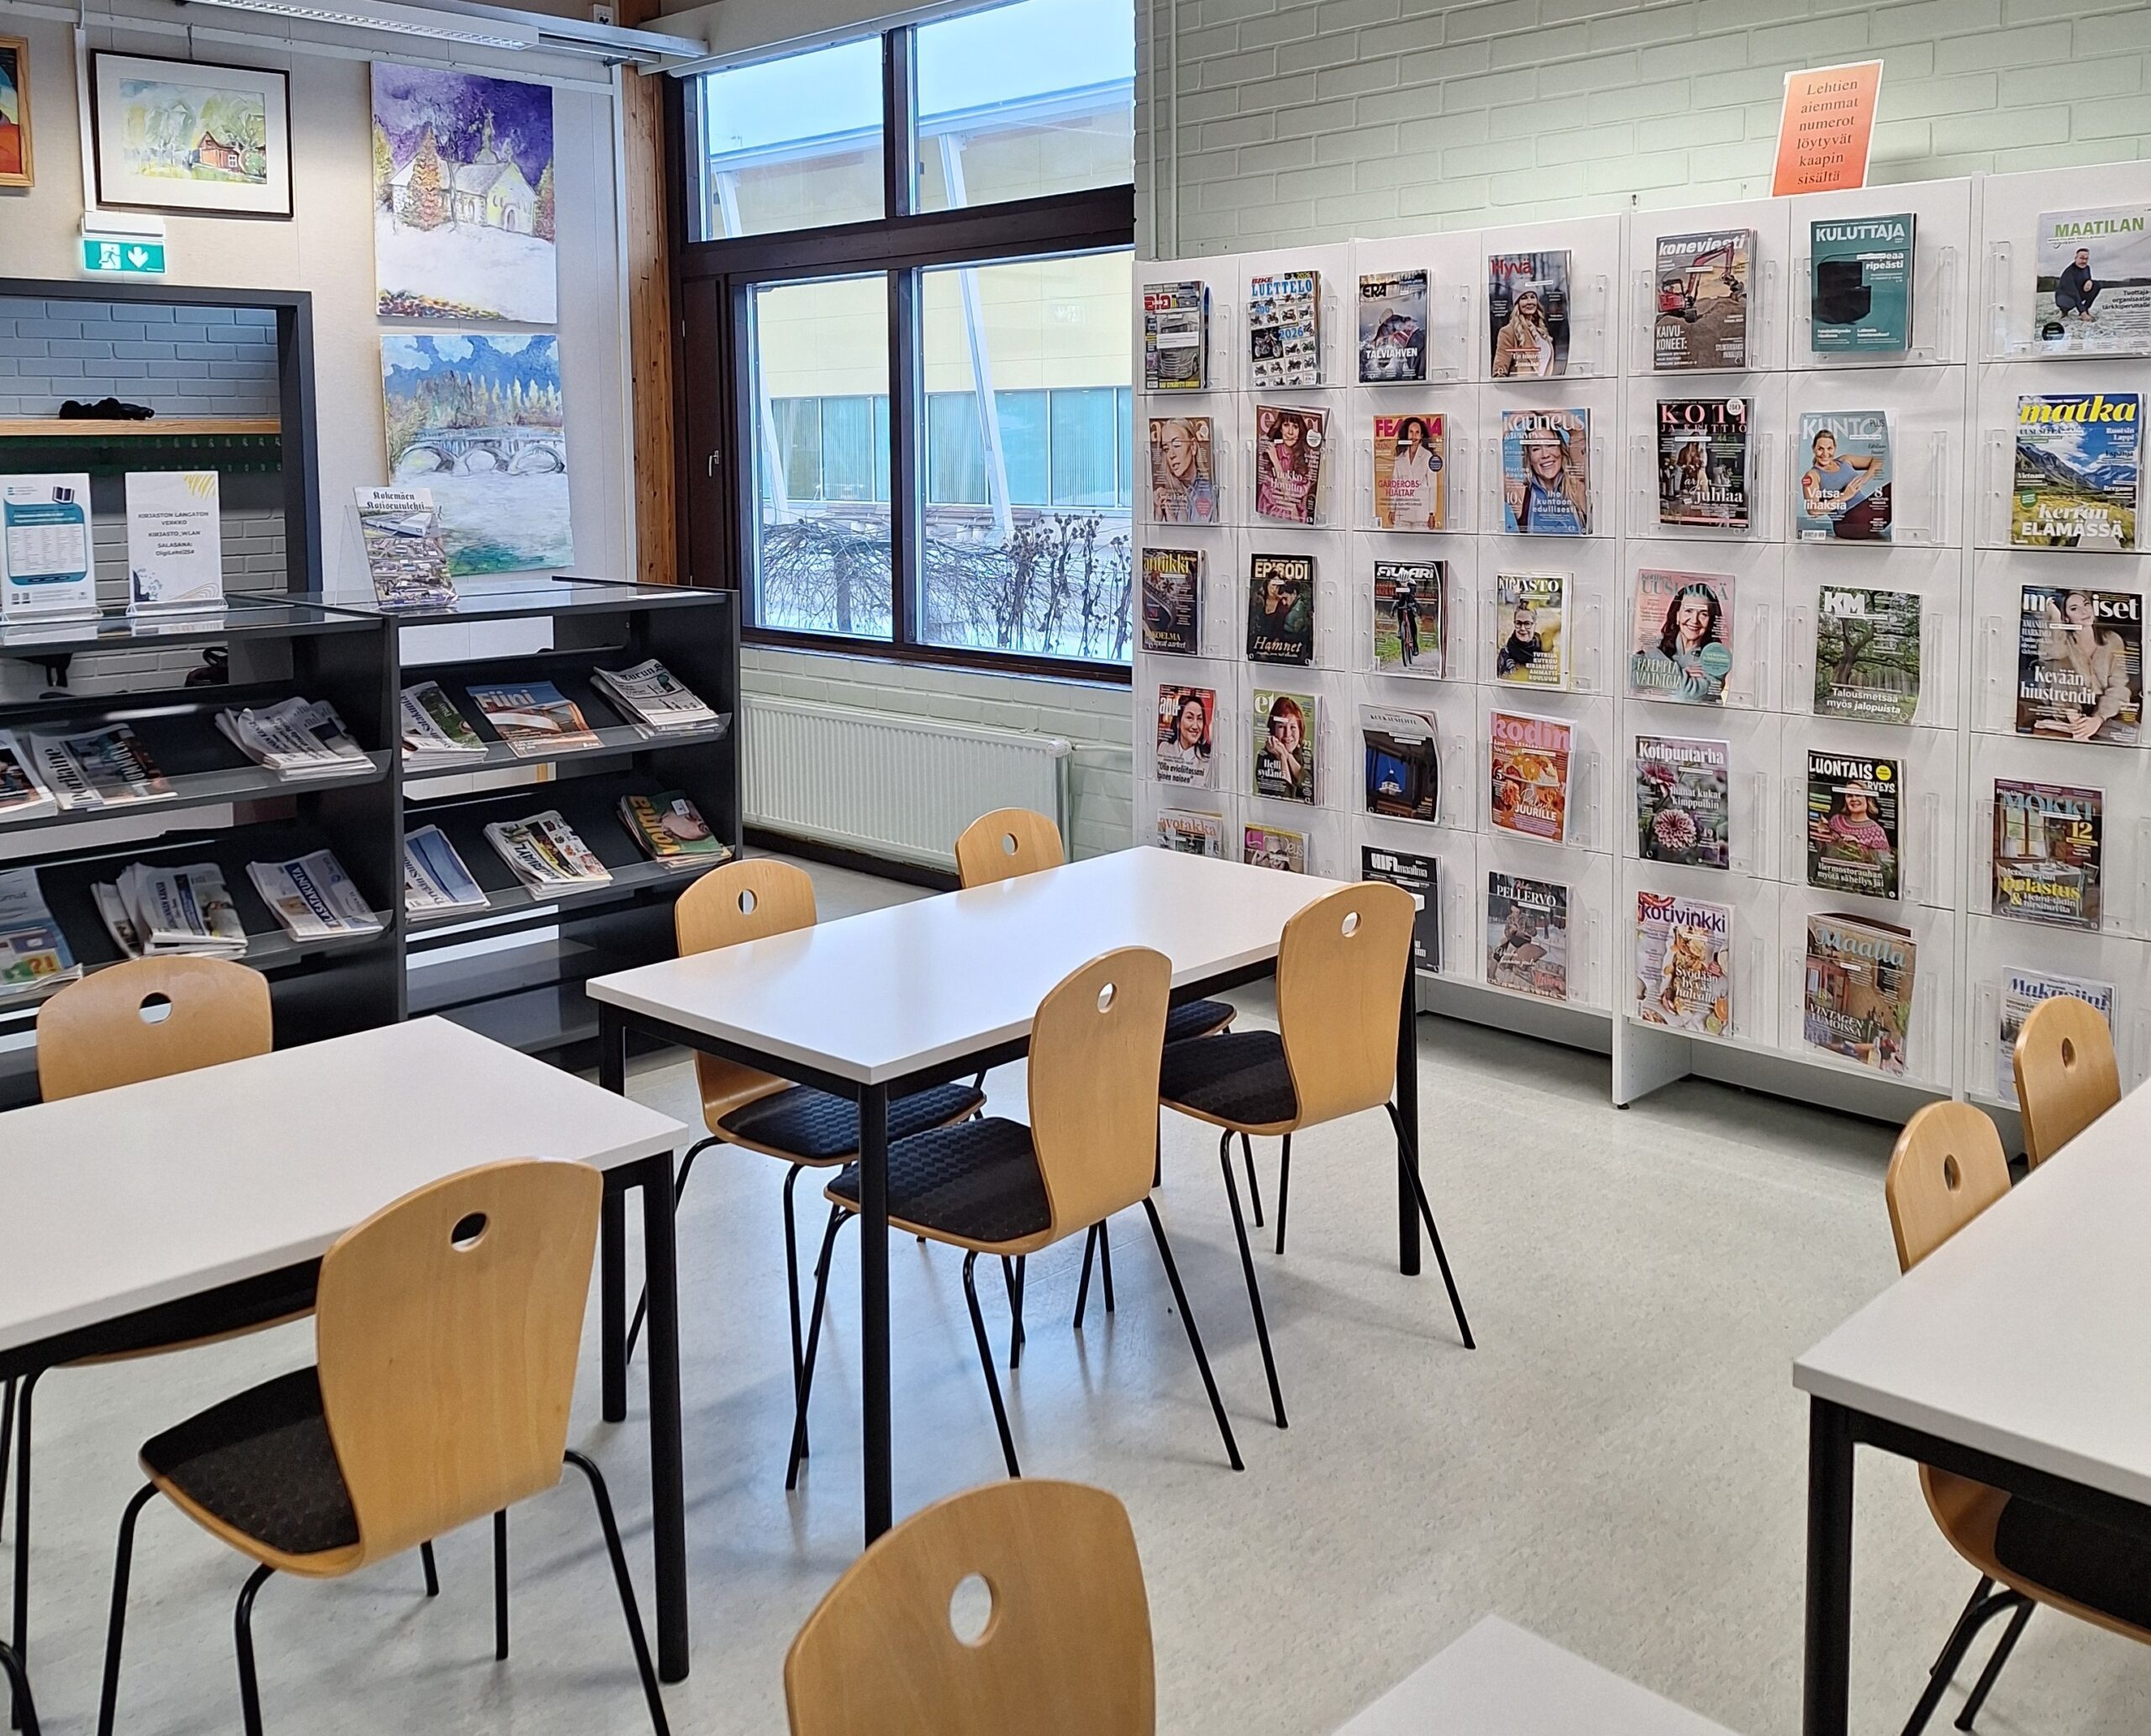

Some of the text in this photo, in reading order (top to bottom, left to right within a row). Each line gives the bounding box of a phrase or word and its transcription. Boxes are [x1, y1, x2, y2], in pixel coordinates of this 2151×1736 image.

[1807, 81, 1858, 95] Lehtien
[1801, 97, 1859, 113] aiemmat
[1799, 115, 1854, 131] numerot
[1796, 134, 1852, 150] löytyvät
[1799, 152, 1843, 167] kaapin
[1798, 171, 1840, 185] sisältä
[1816, 223, 1905, 242] KULUTTAJA
[2054, 217, 2144, 238] MAATILAN
[1491, 258, 1532, 280] Hyvä
[1865, 260, 1904, 271] ripeästi
[1252, 280, 1312, 296] LUETTELO
[1279, 326, 1303, 339] 2026
[1656, 325, 1685, 337] KAIVU-
[1656, 338, 1687, 350] KONEET:
[1366, 347, 1417, 360] TALVIAHVEN
[2020, 395, 2137, 423] matka
[1504, 413, 1585, 431] Kauneus
[1695, 487, 1743, 505] juhlaa
[1807, 487, 1845, 499] Vatsa-
[1803, 498, 1848, 511] lihaksia
[2038, 504, 2108, 520] kerran
[2022, 519, 2124, 538] ELÄMÄSSÄ
[1824, 592, 1865, 614] KM
[1253, 635, 1302, 653] Hamnet
[619, 667, 656, 681] Turun
[2034, 665, 2084, 687] Kevään
[1832, 687, 1899, 703] Talousmetsää
[2020, 681, 2096, 705] hiustrendit
[1159, 696, 1181, 716] apu
[1826, 698, 1901, 714] myös jalopuista
[1492, 713, 1570, 752] kodin
[1638, 742, 1724, 765] Kotipuutarha
[1809, 756, 1873, 780] LUONTAIS
[1697, 787, 1722, 799] kukat
[1672, 796, 1719, 809] kimppuihin
[2004, 790, 2092, 821] MÖKKI
[1515, 805, 1557, 821] JUURILLE
[1160, 815, 1217, 837] avotakka
[2071, 822, 2093, 839] 12
[1496, 885, 1556, 907] PELLERVO
[1640, 903, 1726, 934] kotivinkki
[1817, 925, 1906, 967] Maalla
[1808, 1003, 1864, 1028] VINTAGEN
